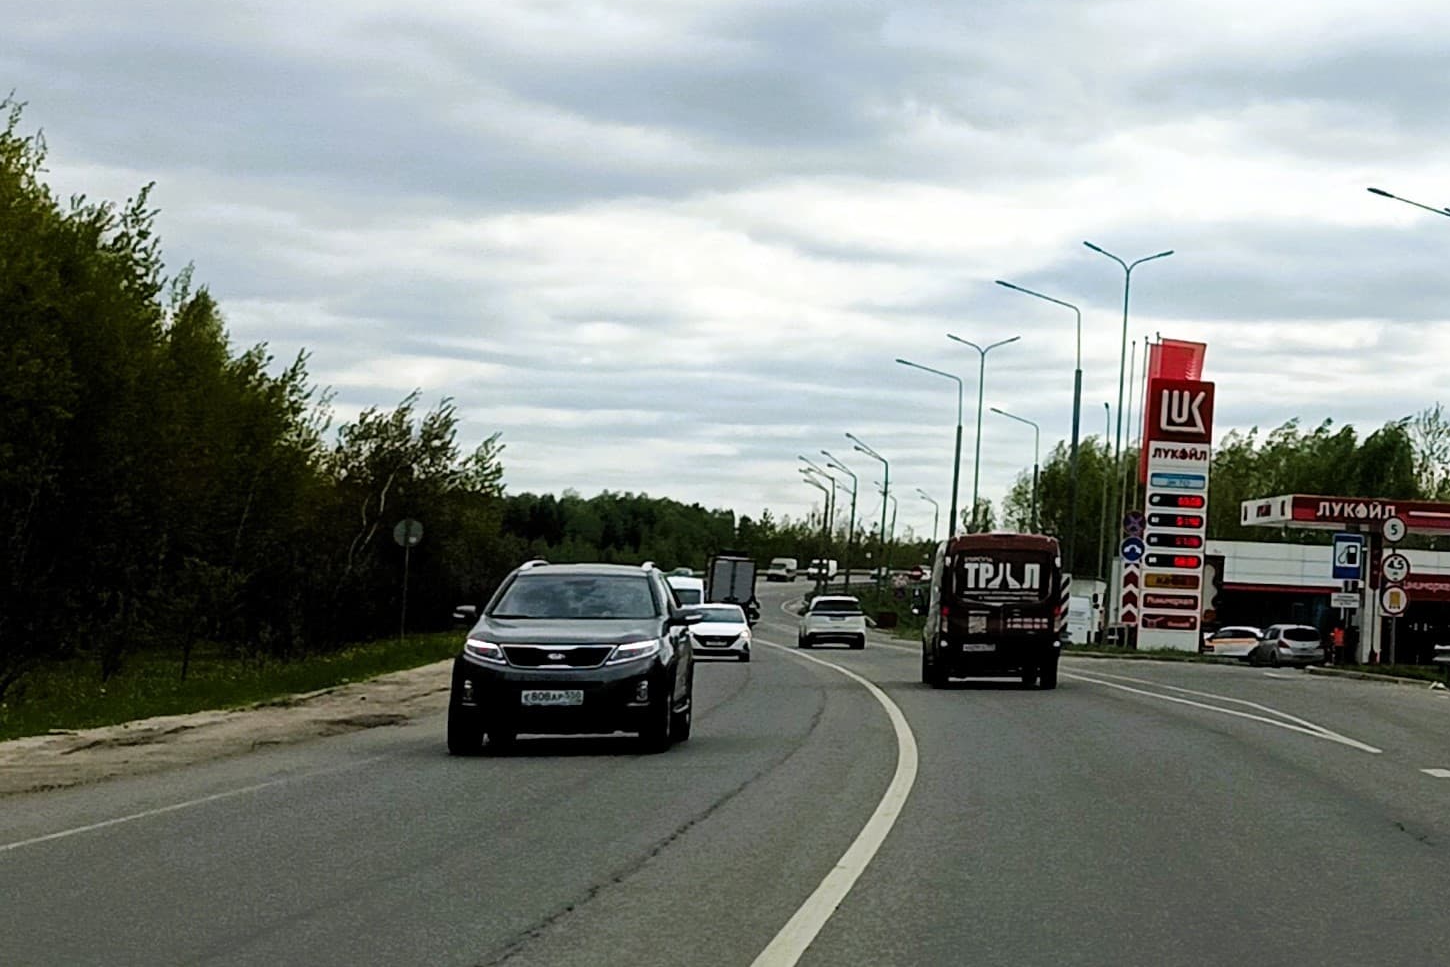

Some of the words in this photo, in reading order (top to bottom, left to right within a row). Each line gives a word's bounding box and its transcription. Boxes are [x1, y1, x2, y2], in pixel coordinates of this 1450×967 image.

[1152, 447, 1207, 461] ЛУКОЙЛ
[1316, 501, 1396, 519] ЛУКОЙЛ
[1390, 524, 1398, 535] 5
